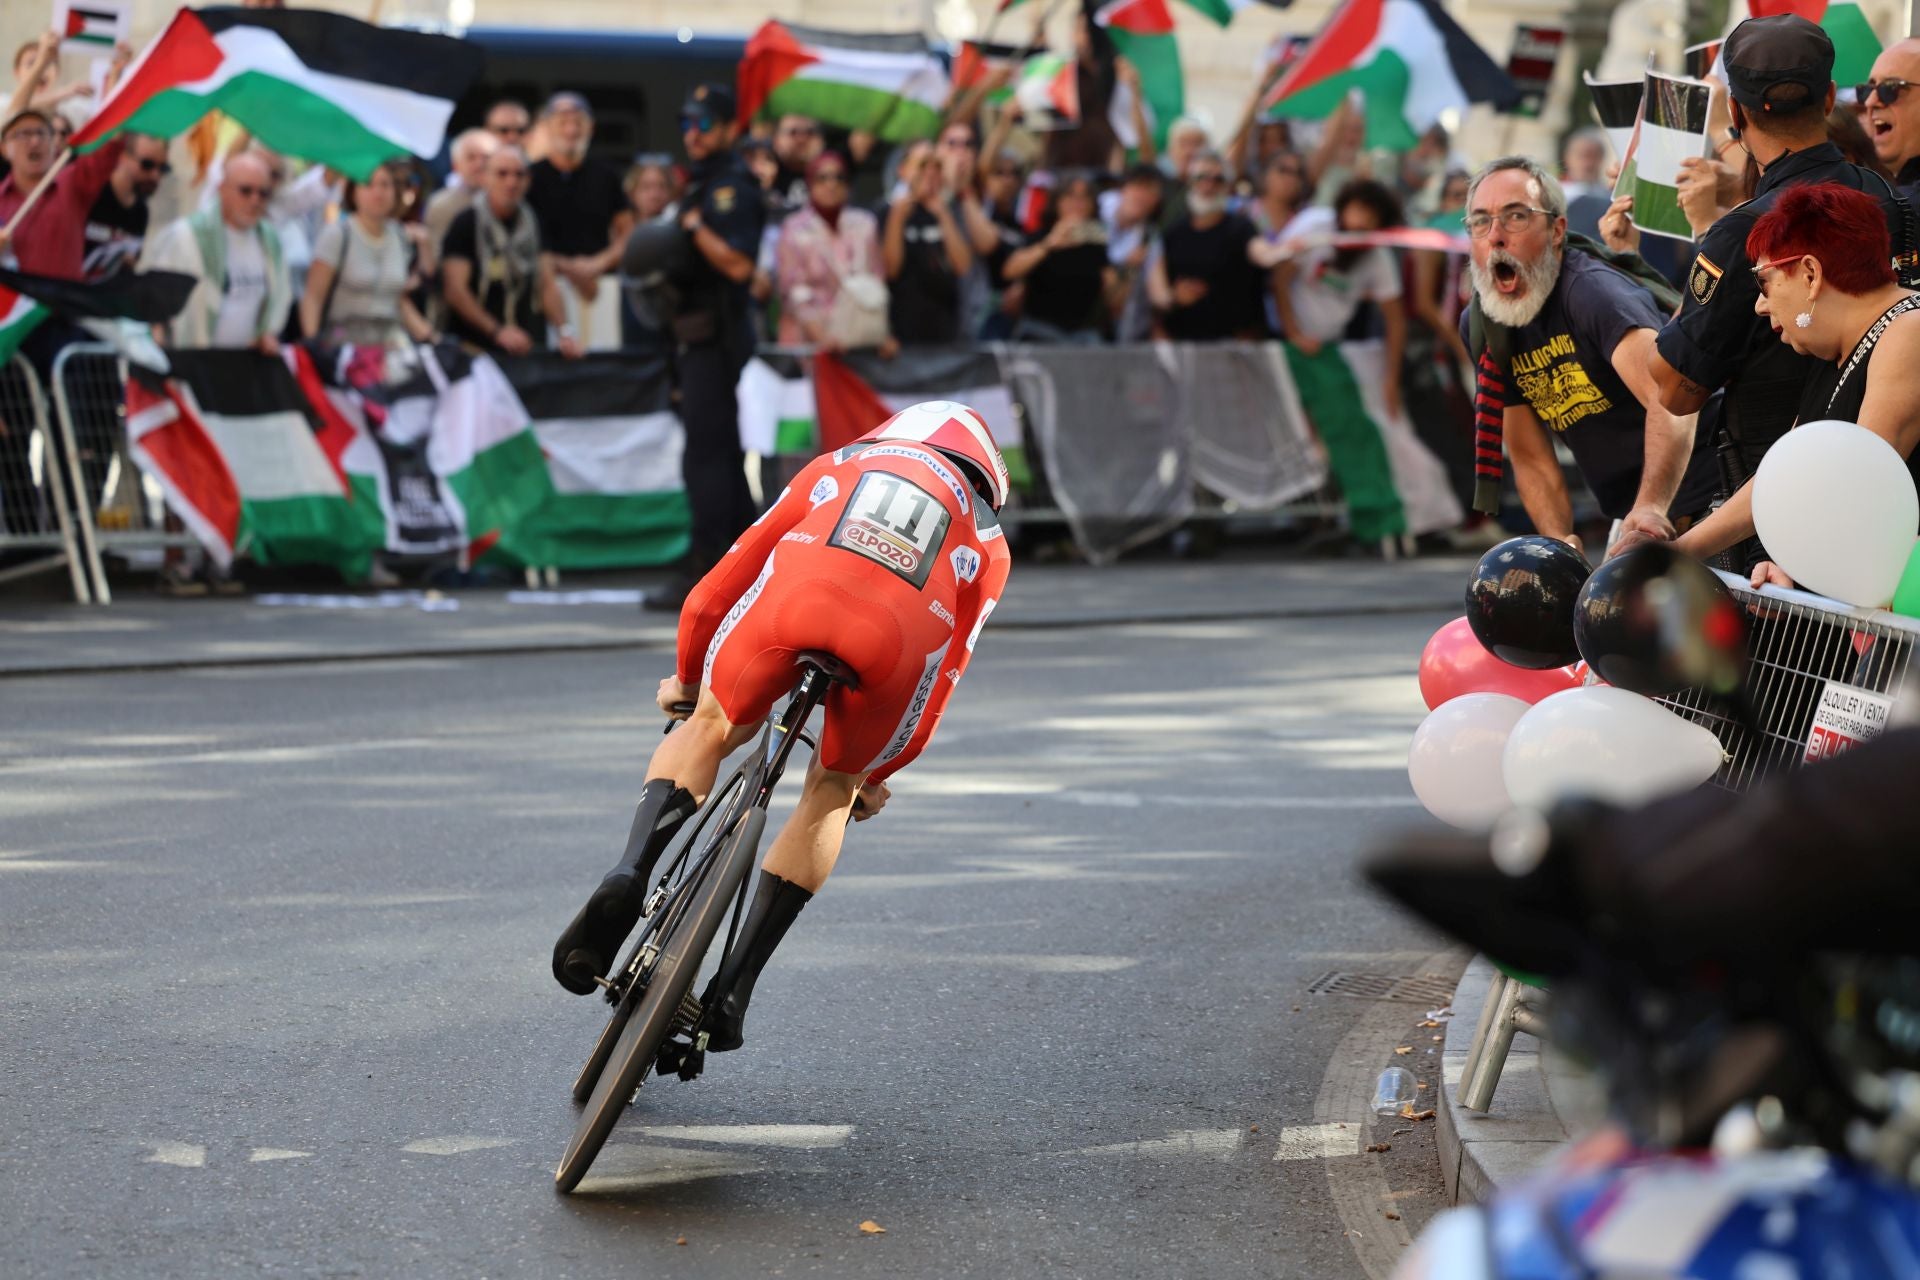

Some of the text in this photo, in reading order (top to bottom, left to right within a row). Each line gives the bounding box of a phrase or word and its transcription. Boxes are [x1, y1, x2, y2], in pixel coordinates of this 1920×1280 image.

[868, 447, 949, 479] Carrefour
[864, 479, 930, 544] 11
[780, 531, 820, 544] antini
[1816, 709, 1826, 723] DE
[1824, 710, 1851, 731] EQUIPOS
[1849, 719, 1863, 736] PARA
[1823, 690, 1886, 725] ALQUILER Y VENTA
[1808, 732, 1849, 760] BLA
